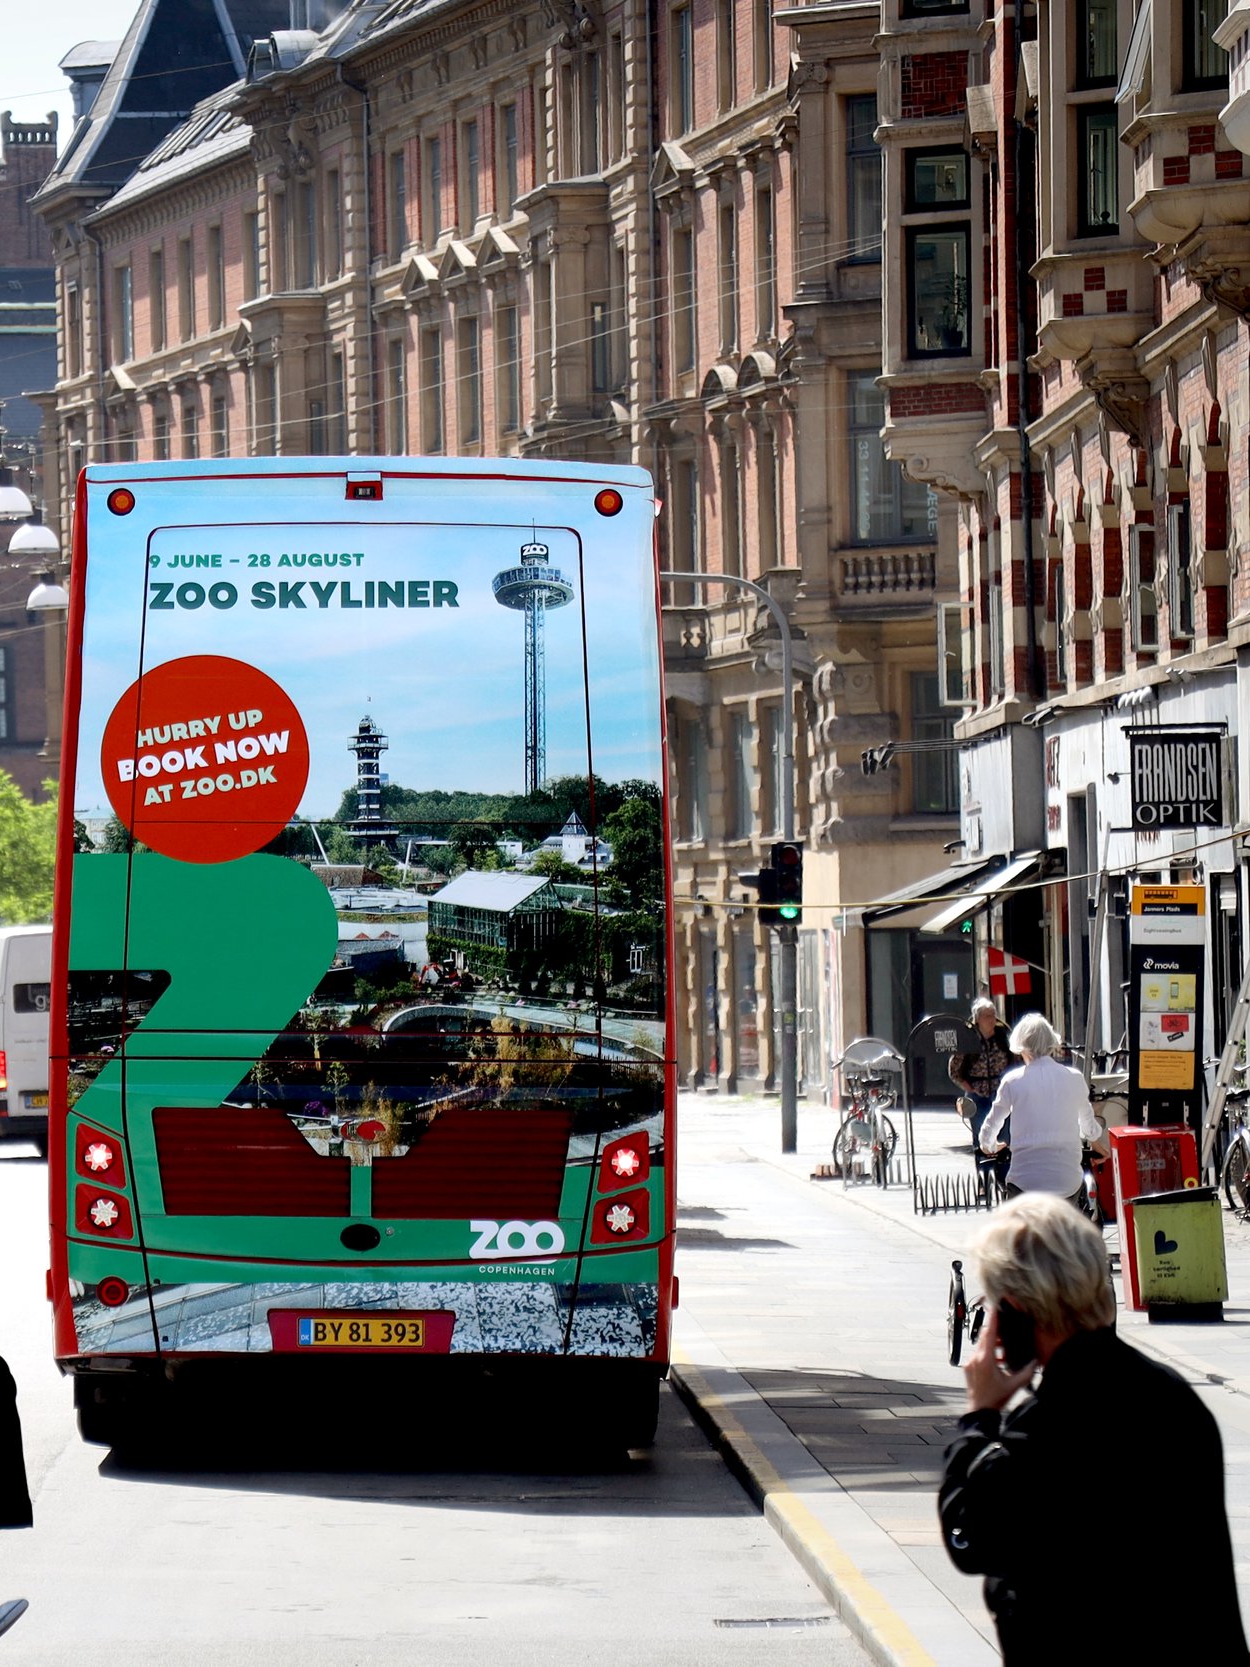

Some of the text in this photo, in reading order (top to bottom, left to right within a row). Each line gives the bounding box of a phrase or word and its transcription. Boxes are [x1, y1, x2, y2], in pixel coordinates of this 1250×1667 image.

[149, 554, 159, 568] 9
[167, 554, 222, 568] JUNE
[247, 553, 271, 567] 28
[277, 552, 365, 567] AUGUST
[522, 544, 547, 556] ZOO
[149, 580, 460, 610] ZOO SKYLINER
[137, 709, 263, 748] HURRY UP
[117, 730, 290, 782] BOOK NOW
[143, 765, 277, 806] AT ZOO.DK
[1134, 743, 1218, 803] FRANDSEN
[1136, 803, 1217, 824] OPTIK
[469, 1220, 565, 1264] ZOO
[479, 1265, 555, 1276] COPENHAGEN
[314, 1322, 420, 1343] BY 81 393
